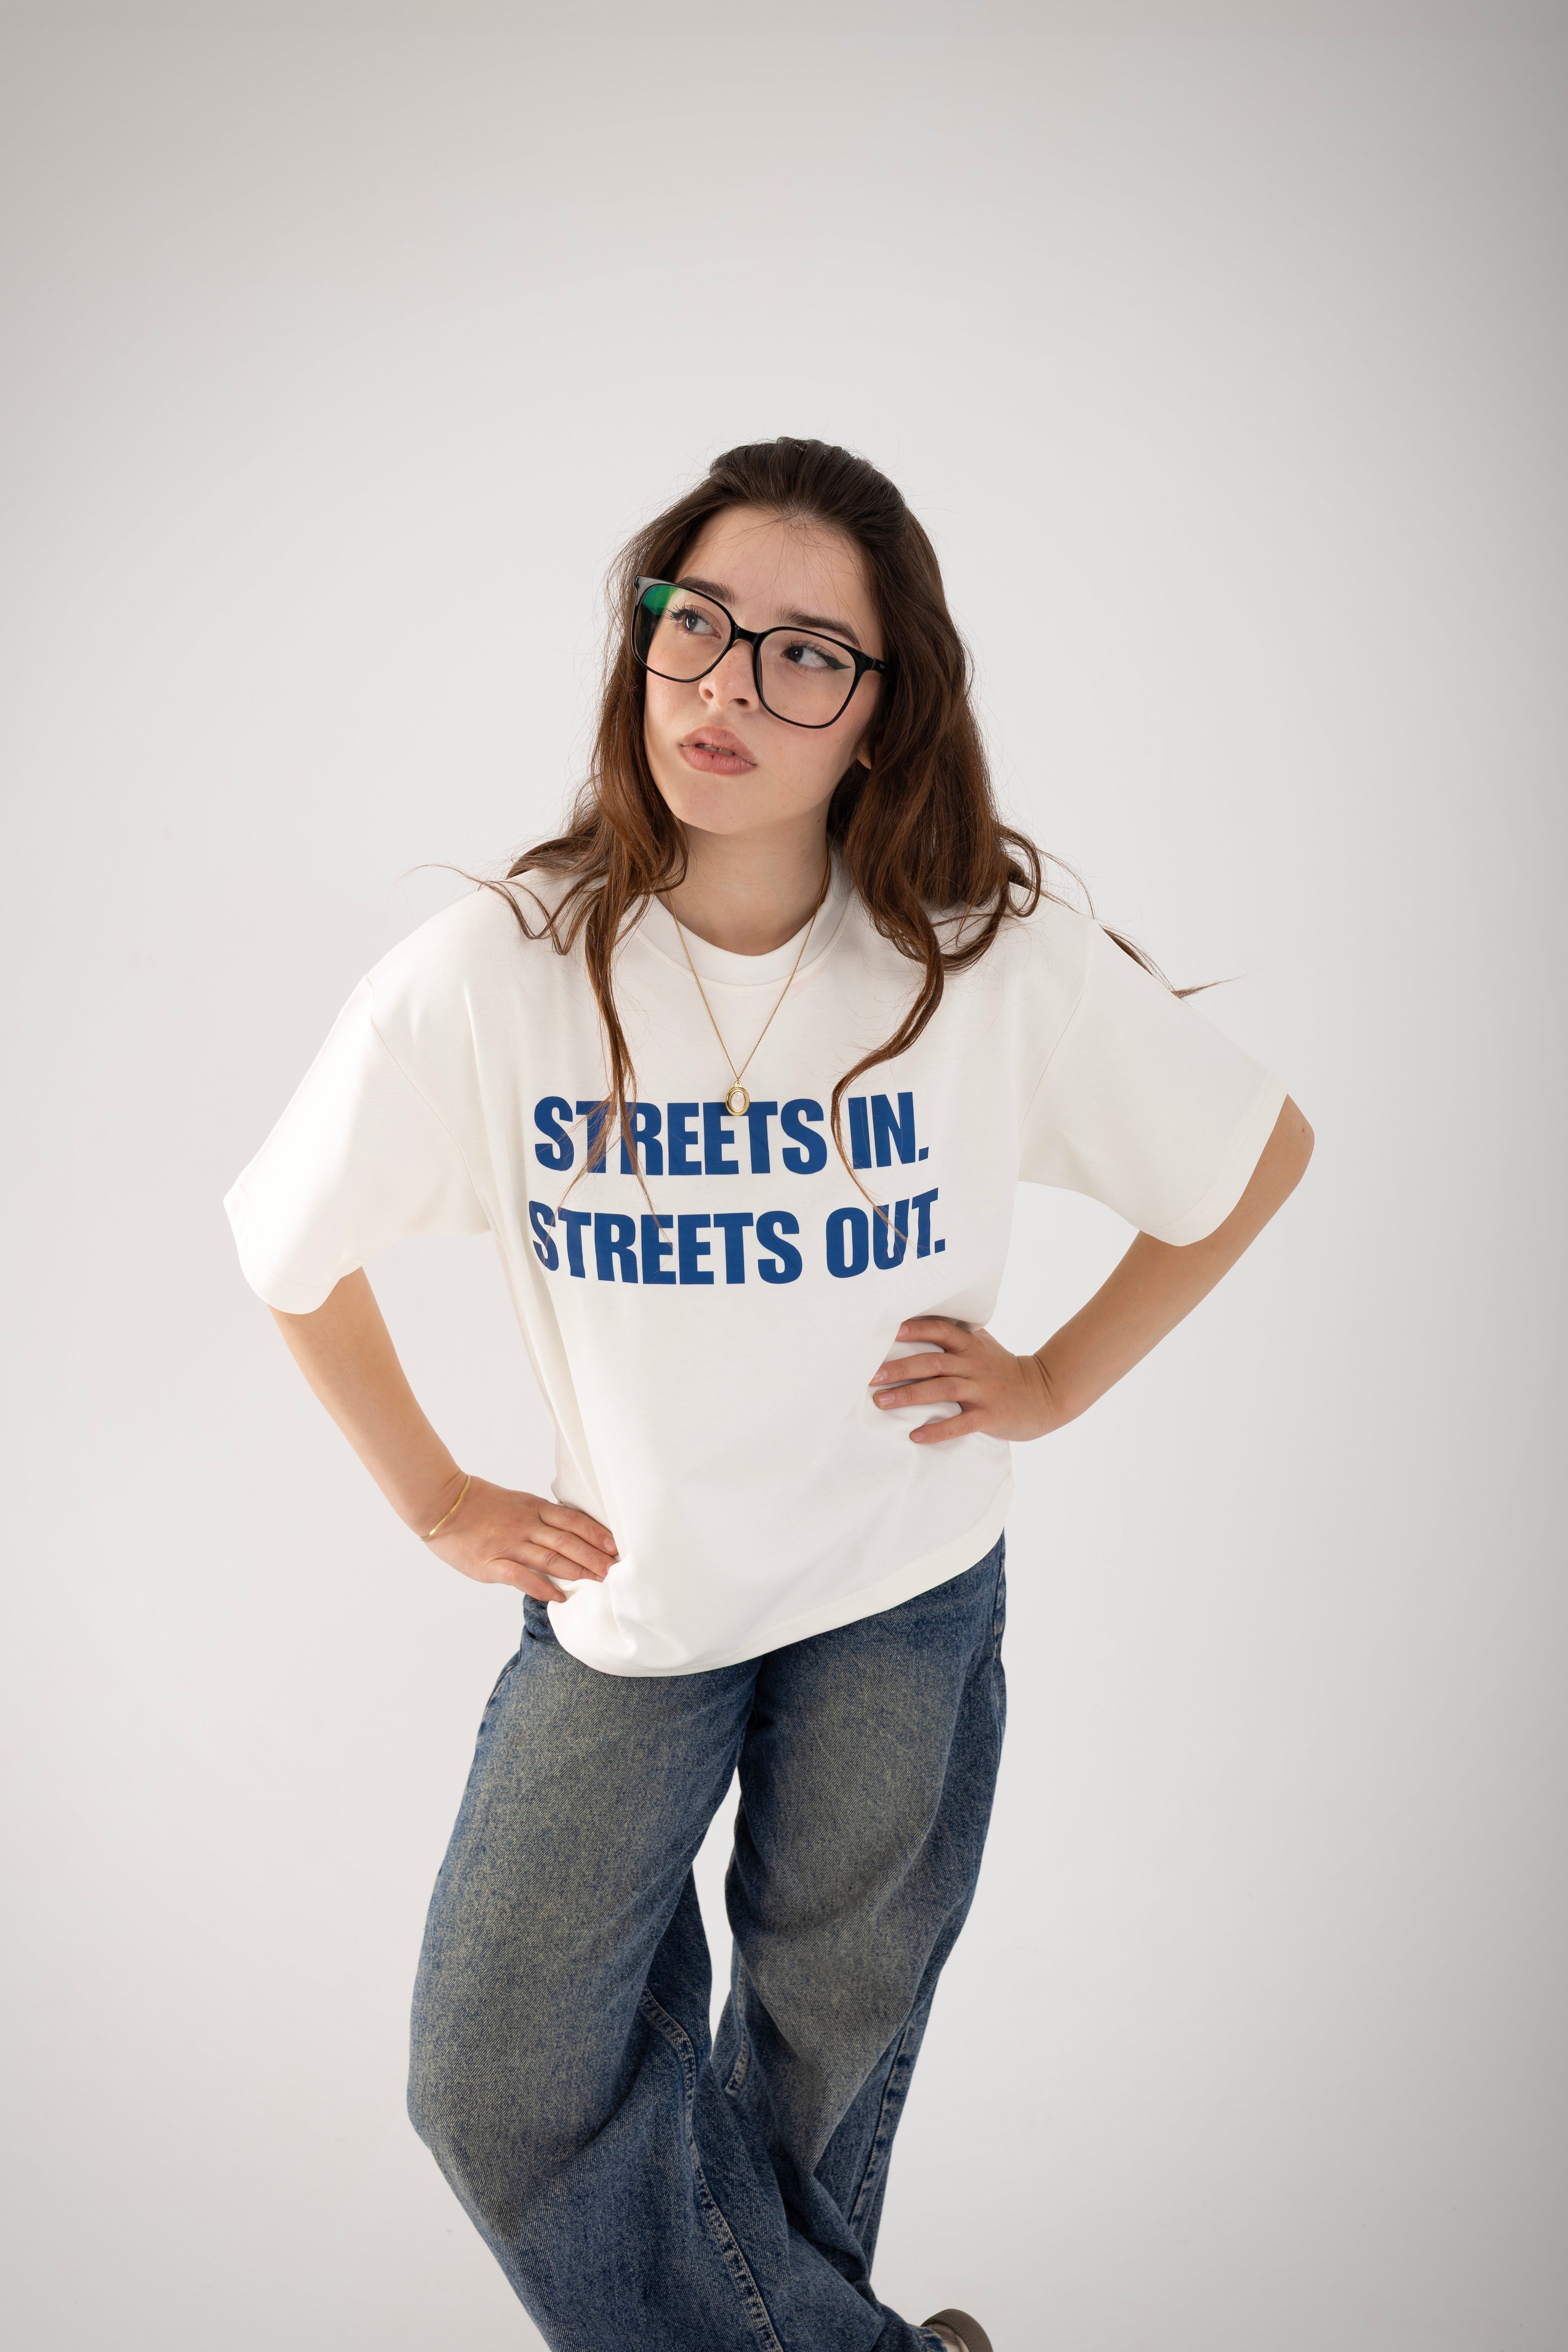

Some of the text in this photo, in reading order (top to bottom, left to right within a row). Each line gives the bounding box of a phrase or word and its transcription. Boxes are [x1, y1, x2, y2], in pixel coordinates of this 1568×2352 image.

[534, 1091, 929, 1176] STREETS IN.
[529, 1187, 946, 1285] STREETS OUT.
